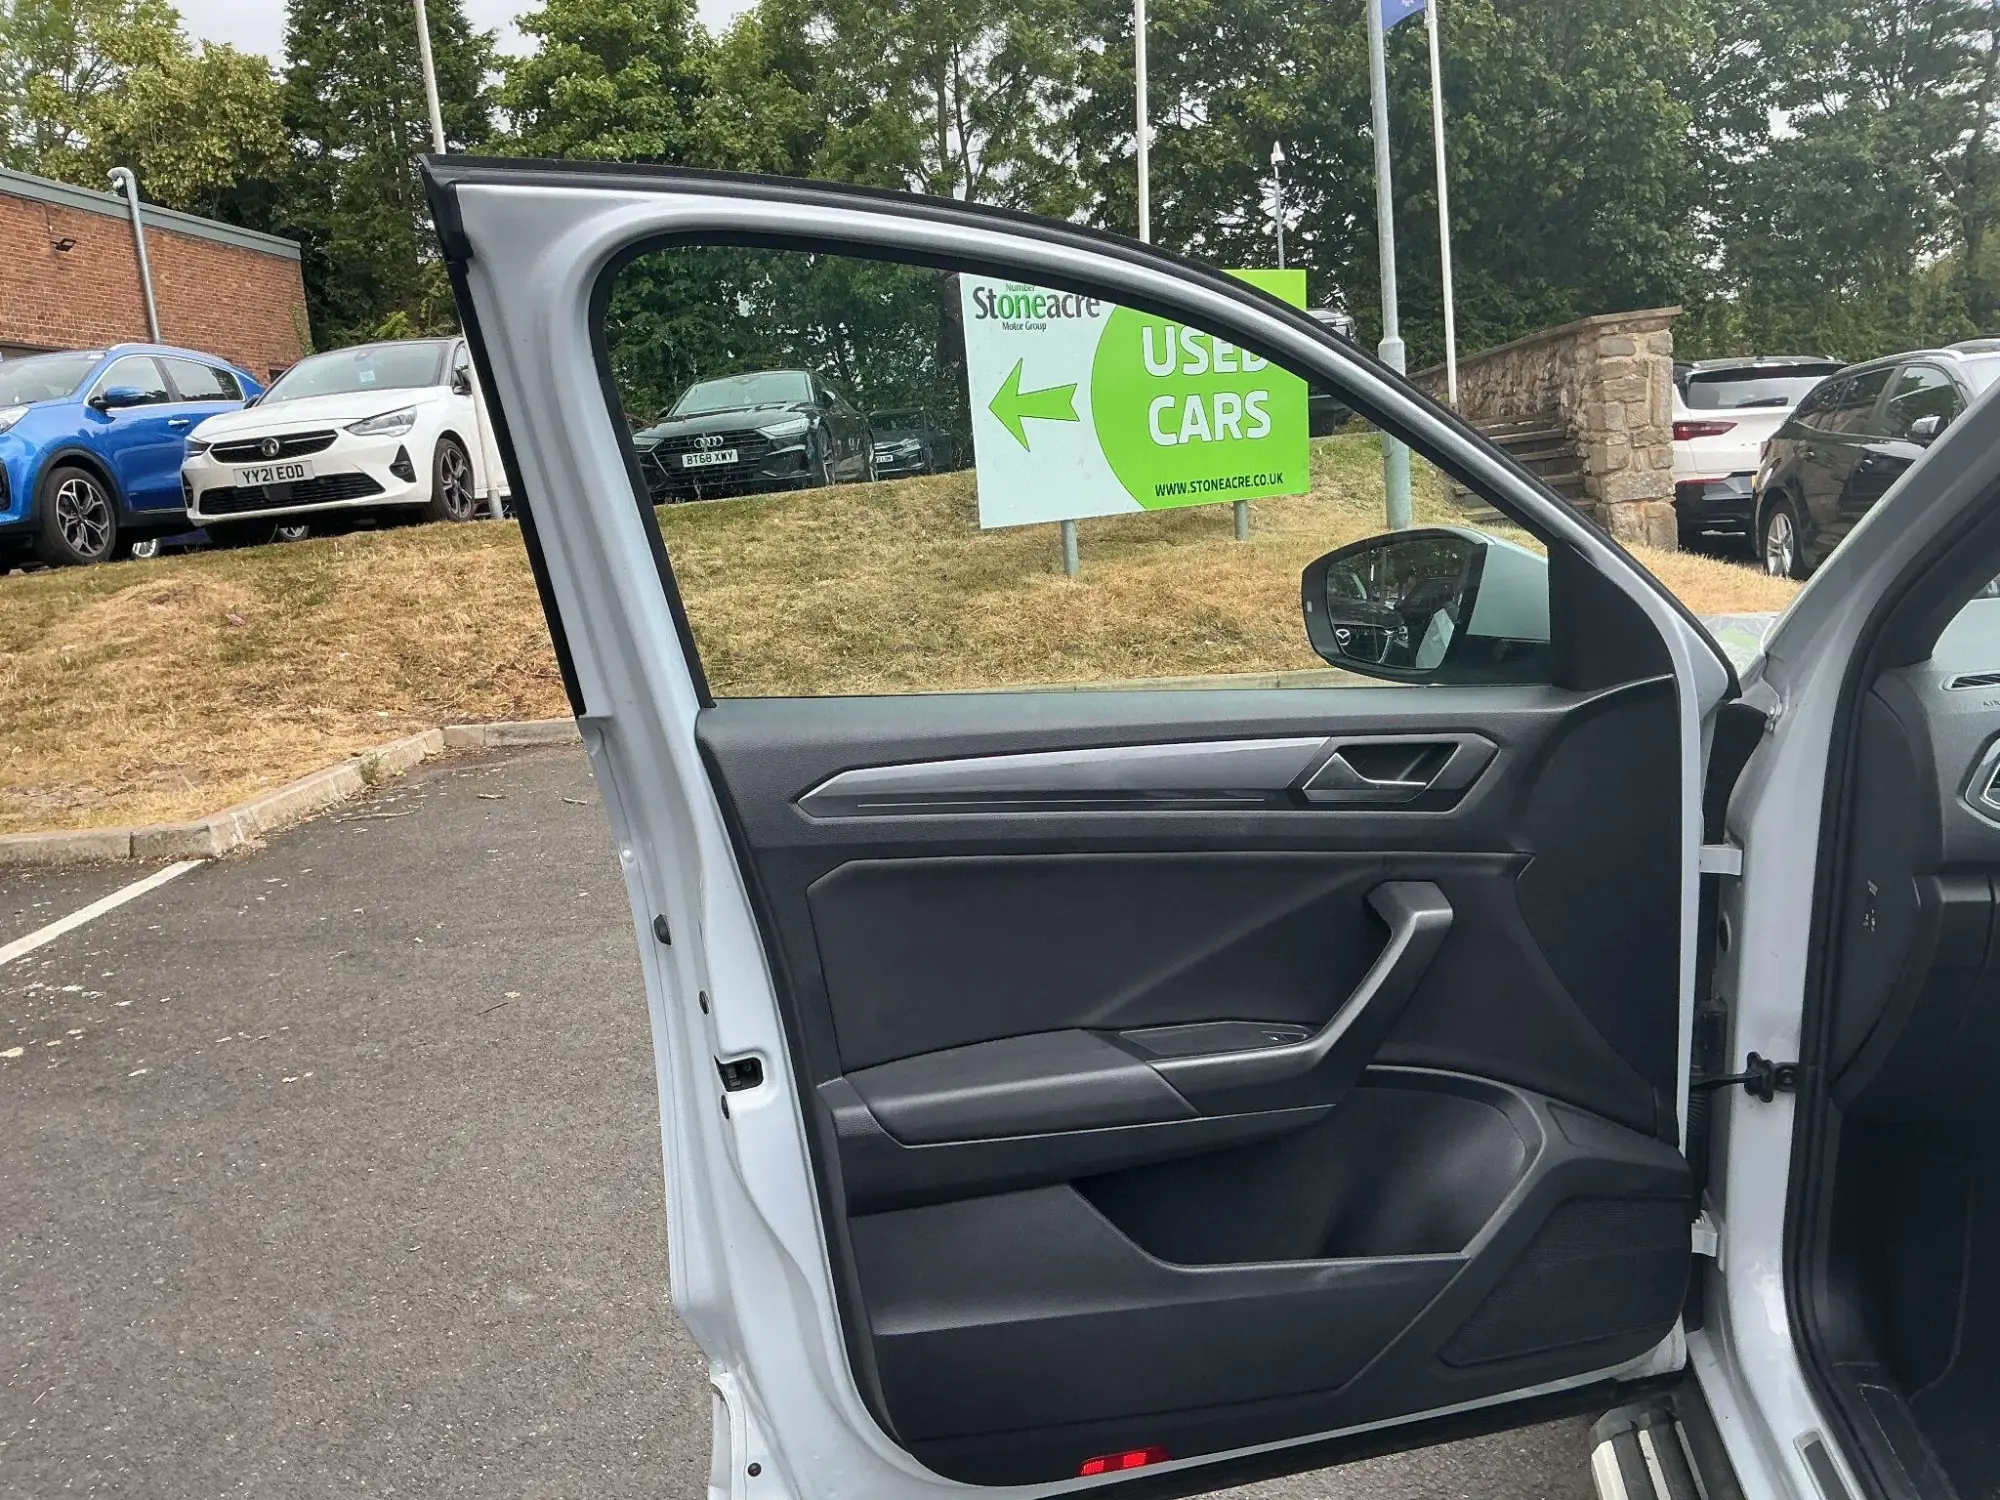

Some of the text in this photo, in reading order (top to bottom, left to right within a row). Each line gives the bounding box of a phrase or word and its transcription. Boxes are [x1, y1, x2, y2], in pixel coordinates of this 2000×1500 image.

[972, 286, 1101, 320] Stoneacre
[1002, 320, 1047, 332] Motor Group
[1148, 389, 1272, 446] CARS
[686, 454, 712, 464] BT68
[243, 465, 304, 483] YY21 EOD
[1155, 472, 1284, 497] WWW.STONEACRE.CO.UK
